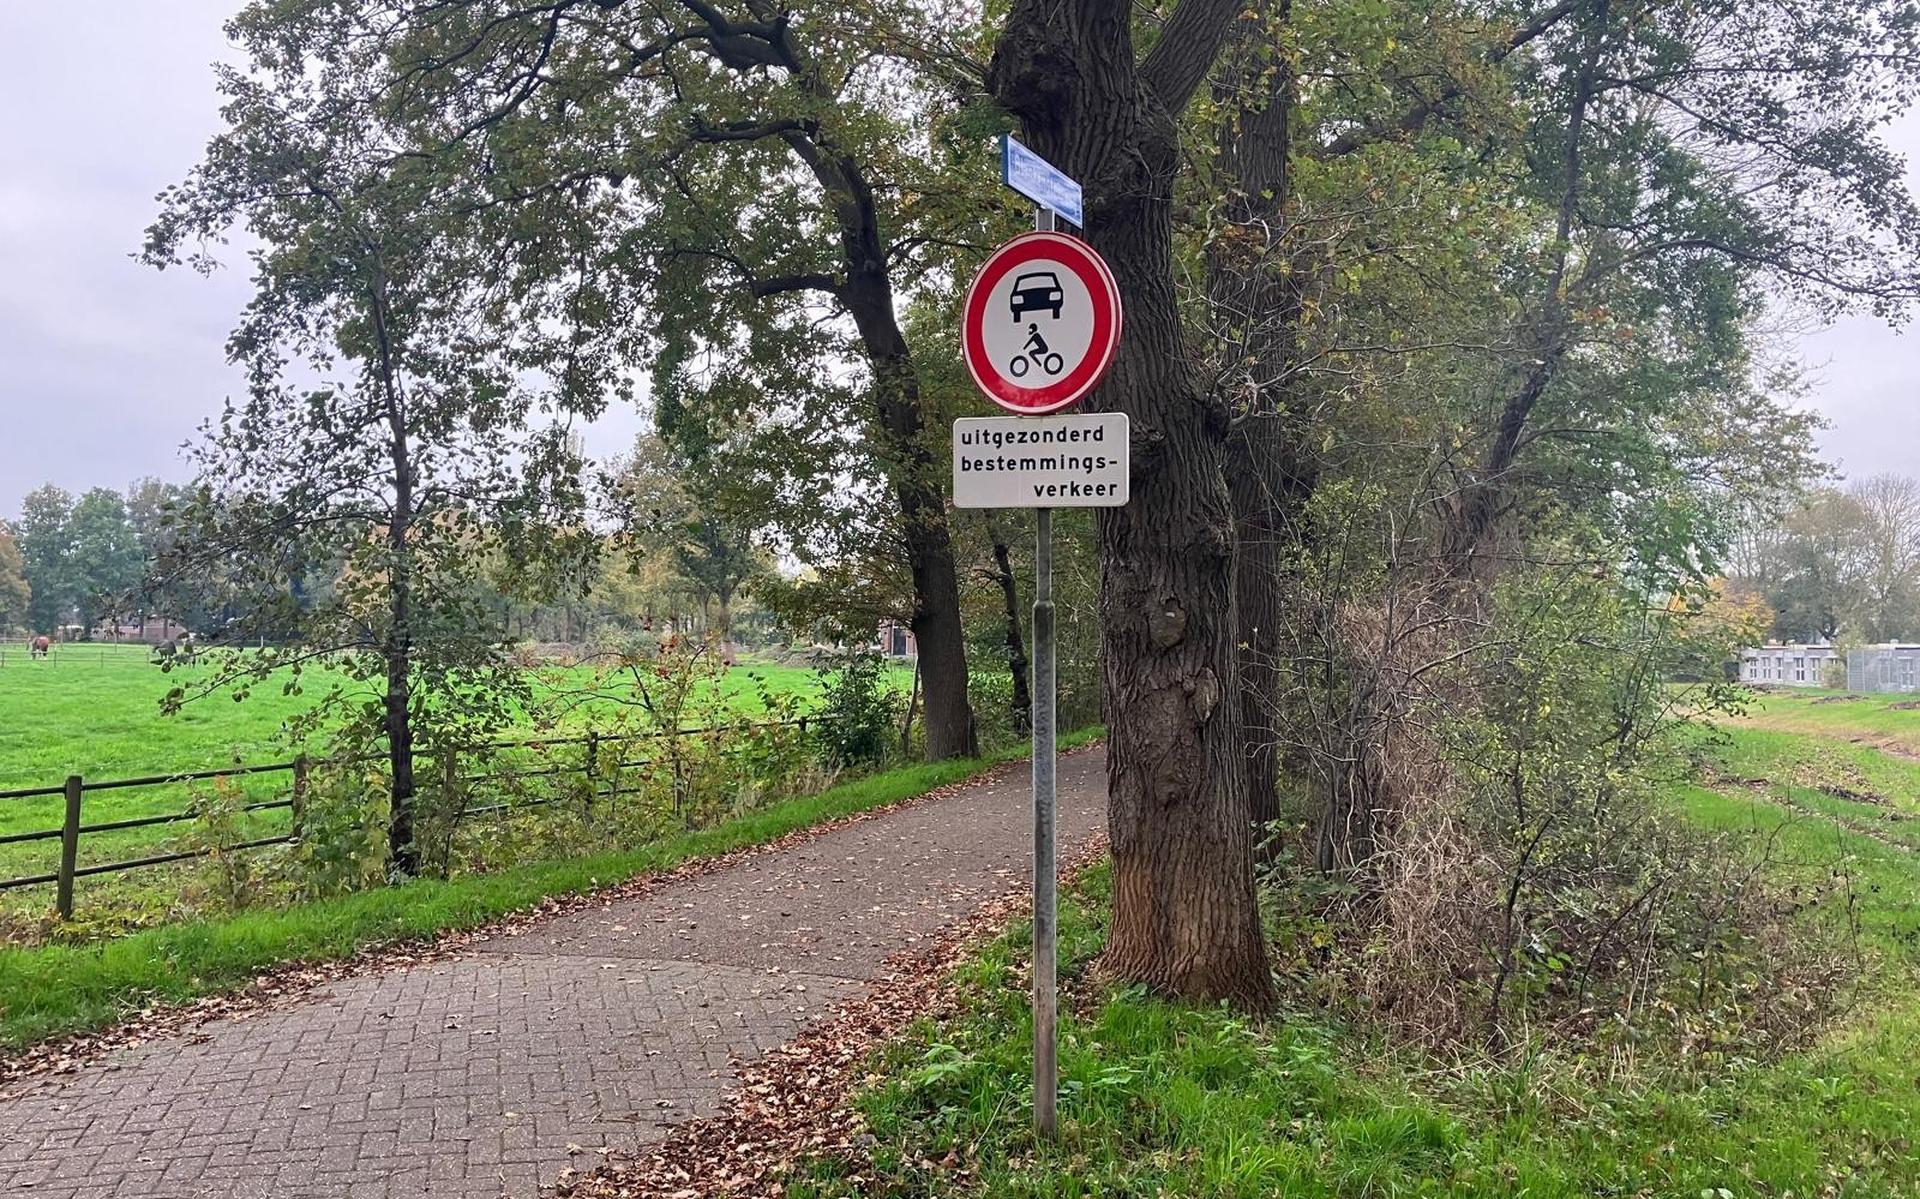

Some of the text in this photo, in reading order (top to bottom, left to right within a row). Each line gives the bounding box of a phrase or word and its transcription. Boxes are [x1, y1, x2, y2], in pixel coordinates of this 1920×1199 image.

[961, 425, 1104, 449] uitgezonderd
[961, 454, 1118, 474] bestemmings-
[1033, 481, 1118, 497] verkeer
